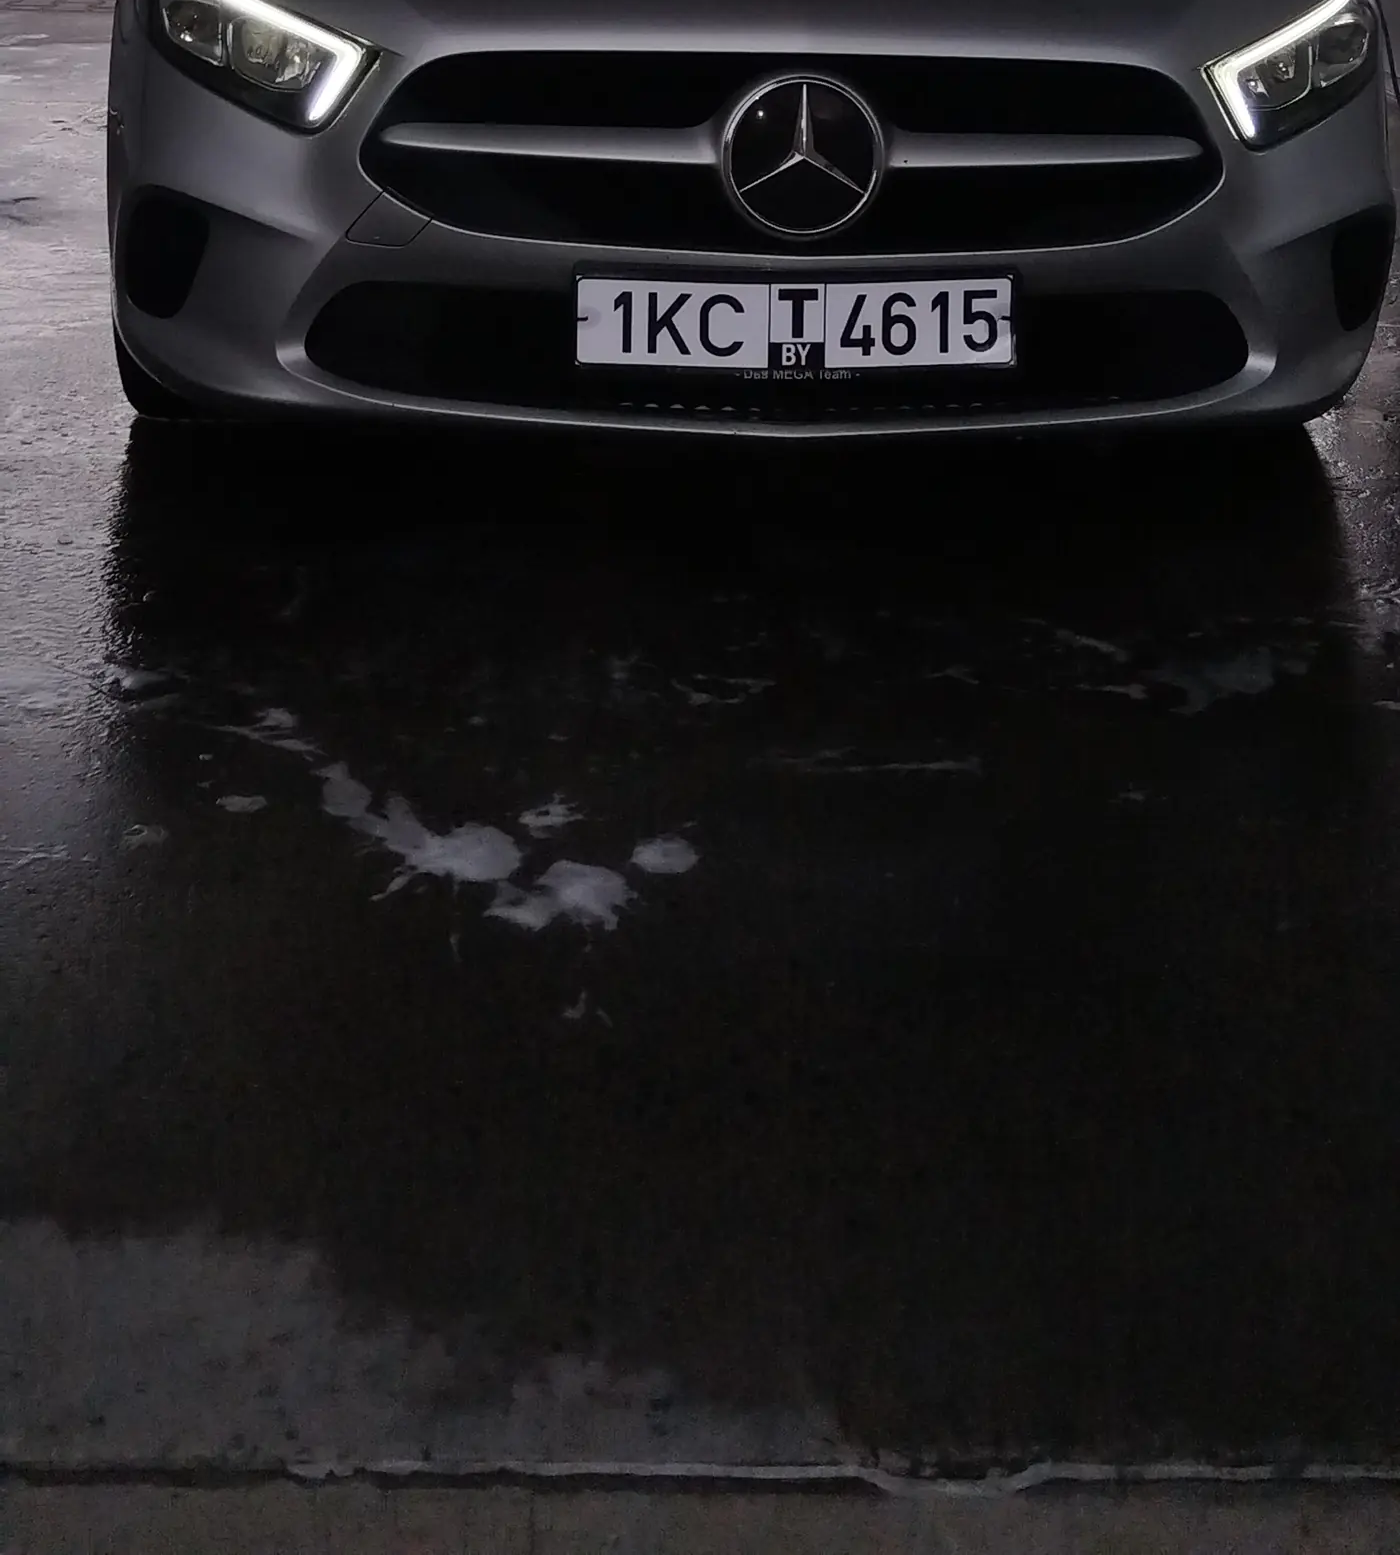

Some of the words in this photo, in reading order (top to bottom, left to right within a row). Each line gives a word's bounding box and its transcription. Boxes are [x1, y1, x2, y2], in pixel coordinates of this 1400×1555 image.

[613, 291, 745, 357] 1KC
[778, 288, 819, 339] T
[840, 290, 999, 357] 4615
[781, 344, 811, 366] BY
[772, 369, 814, 380] MEGA
[819, 369, 852, 380] Team
